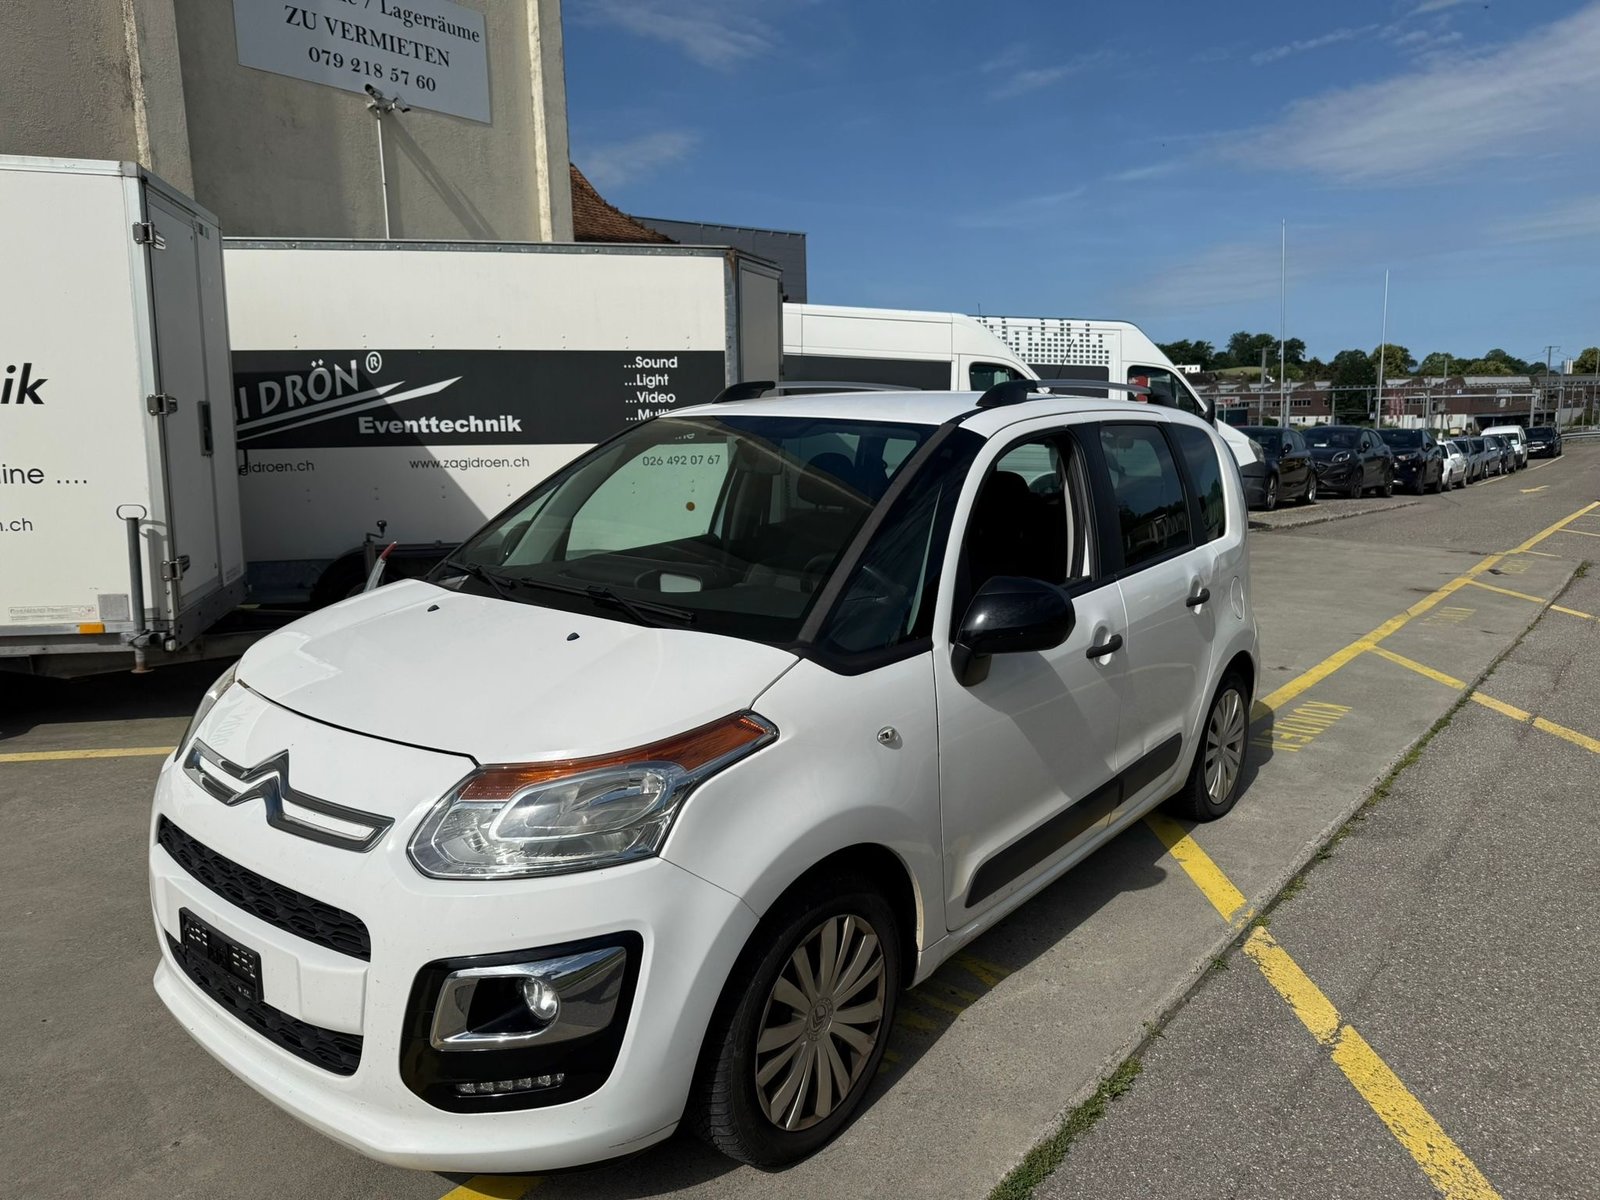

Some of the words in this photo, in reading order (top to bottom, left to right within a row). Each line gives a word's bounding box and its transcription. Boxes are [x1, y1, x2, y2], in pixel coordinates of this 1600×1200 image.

[380, 0, 480, 42] Lagerräume
[284, 5, 317, 30] ZU
[323, 16, 450, 67] VERMIETEN
[308, 46, 344, 68] 079
[350, 57, 383, 79] 218
[389, 67, 409, 86] 57
[416, 74, 436, 92] 60
[358, 415, 522, 434] Eventtechnik
[409, 457, 530, 471] www.zagidroen.ch
[642, 456, 663, 466] 026
[667, 455, 687, 465] 492
[690, 455, 704, 465] 07
[707, 454, 721, 465] 67
[0, 464, 45, 484] ine
